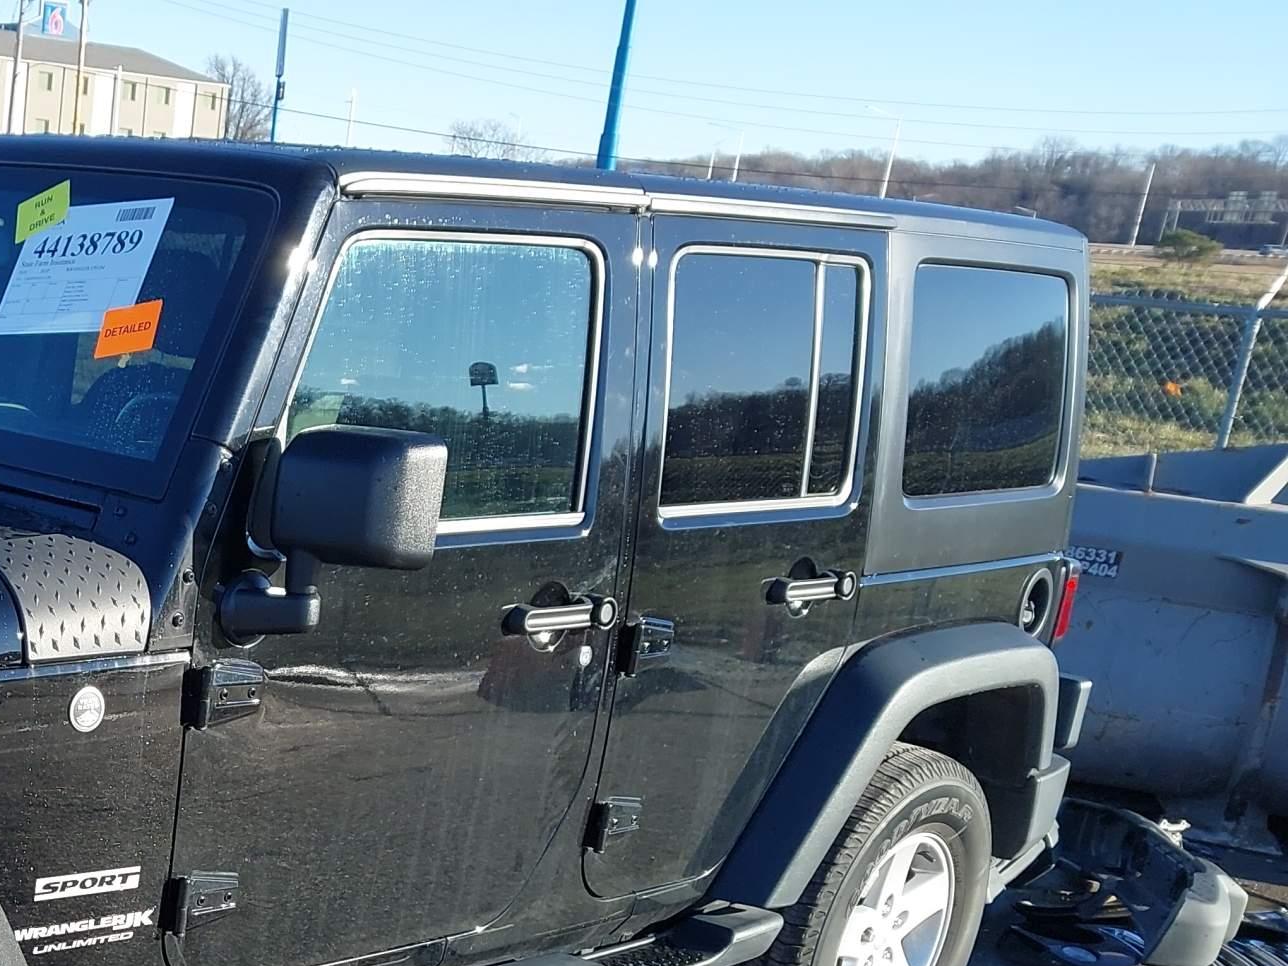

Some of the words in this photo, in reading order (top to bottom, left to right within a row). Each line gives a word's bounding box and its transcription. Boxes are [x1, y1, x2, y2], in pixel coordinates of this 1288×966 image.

[34, 195, 53, 209] RUN
[29, 213, 55, 231] DRIVE
[33, 229, 143, 259] 44138789
[104, 321, 152, 338] DETAILED
[38, 871, 136, 895] SPORT
[32, 931, 134, 955] UNLIMITED
